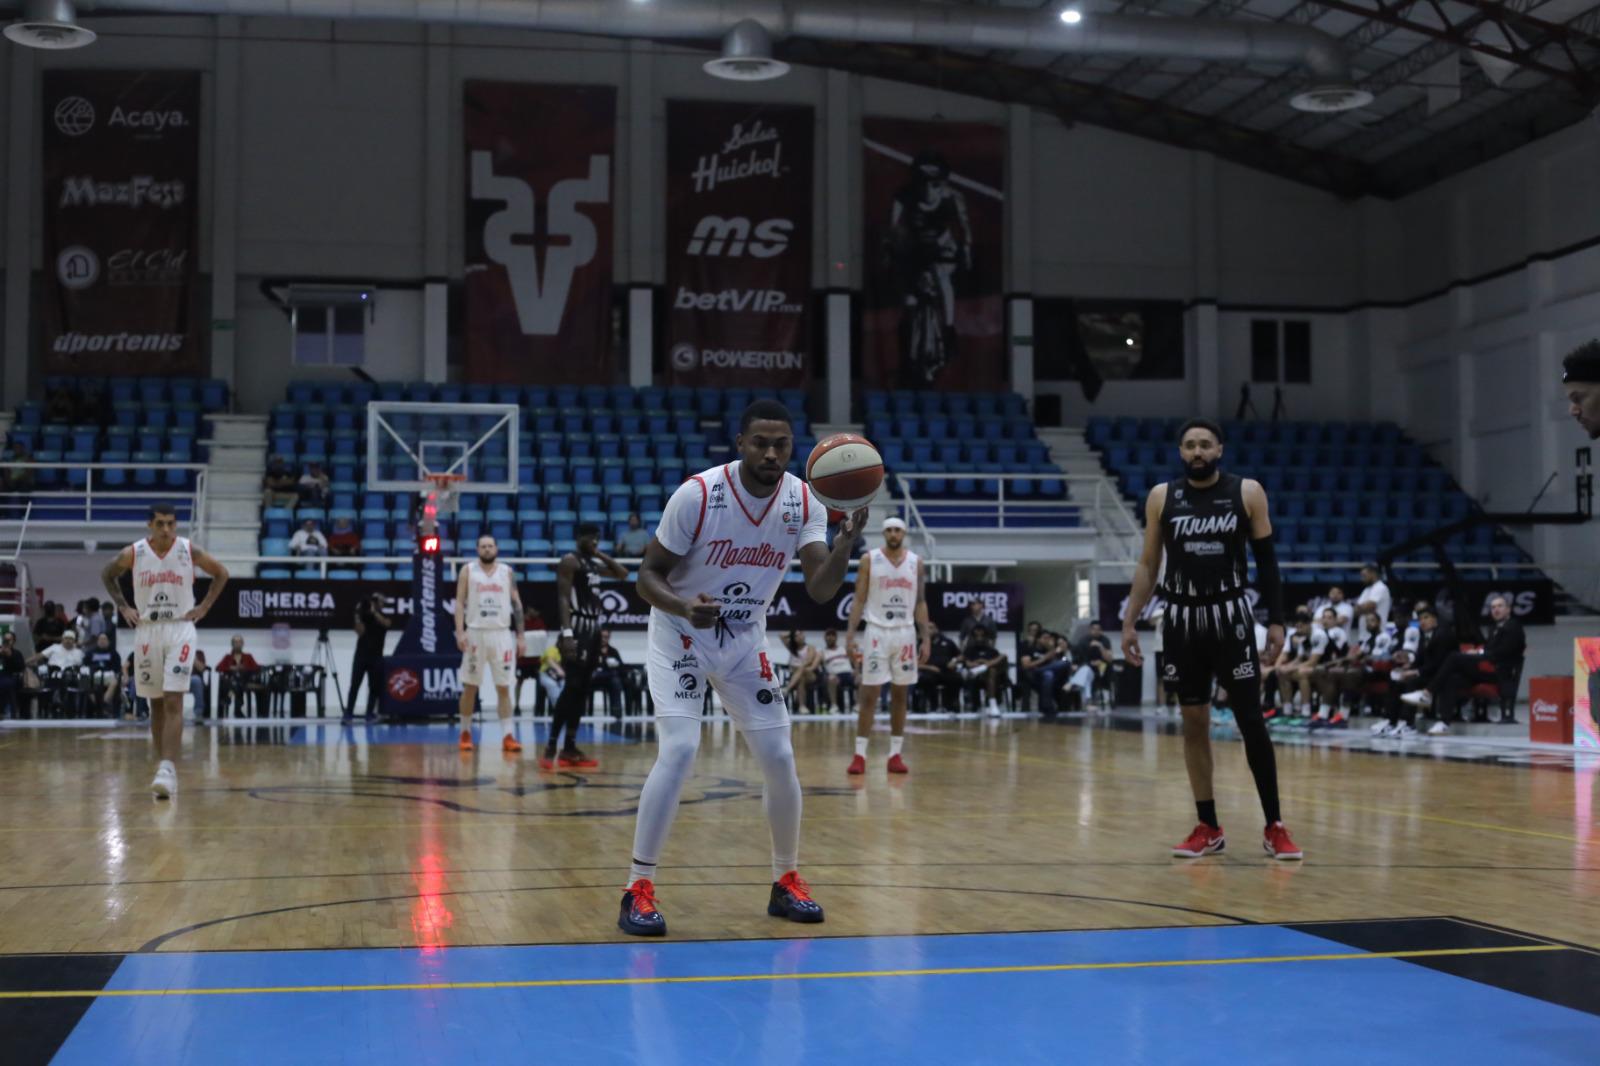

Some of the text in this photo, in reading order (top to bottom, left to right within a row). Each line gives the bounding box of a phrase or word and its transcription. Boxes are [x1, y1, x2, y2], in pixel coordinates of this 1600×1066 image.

[701, 349, 803, 369] POWERTUN
[1170, 511, 1238, 539] TIJUANA
[265, 592, 336, 608] HERSA
[179, 644, 190, 663] 9
